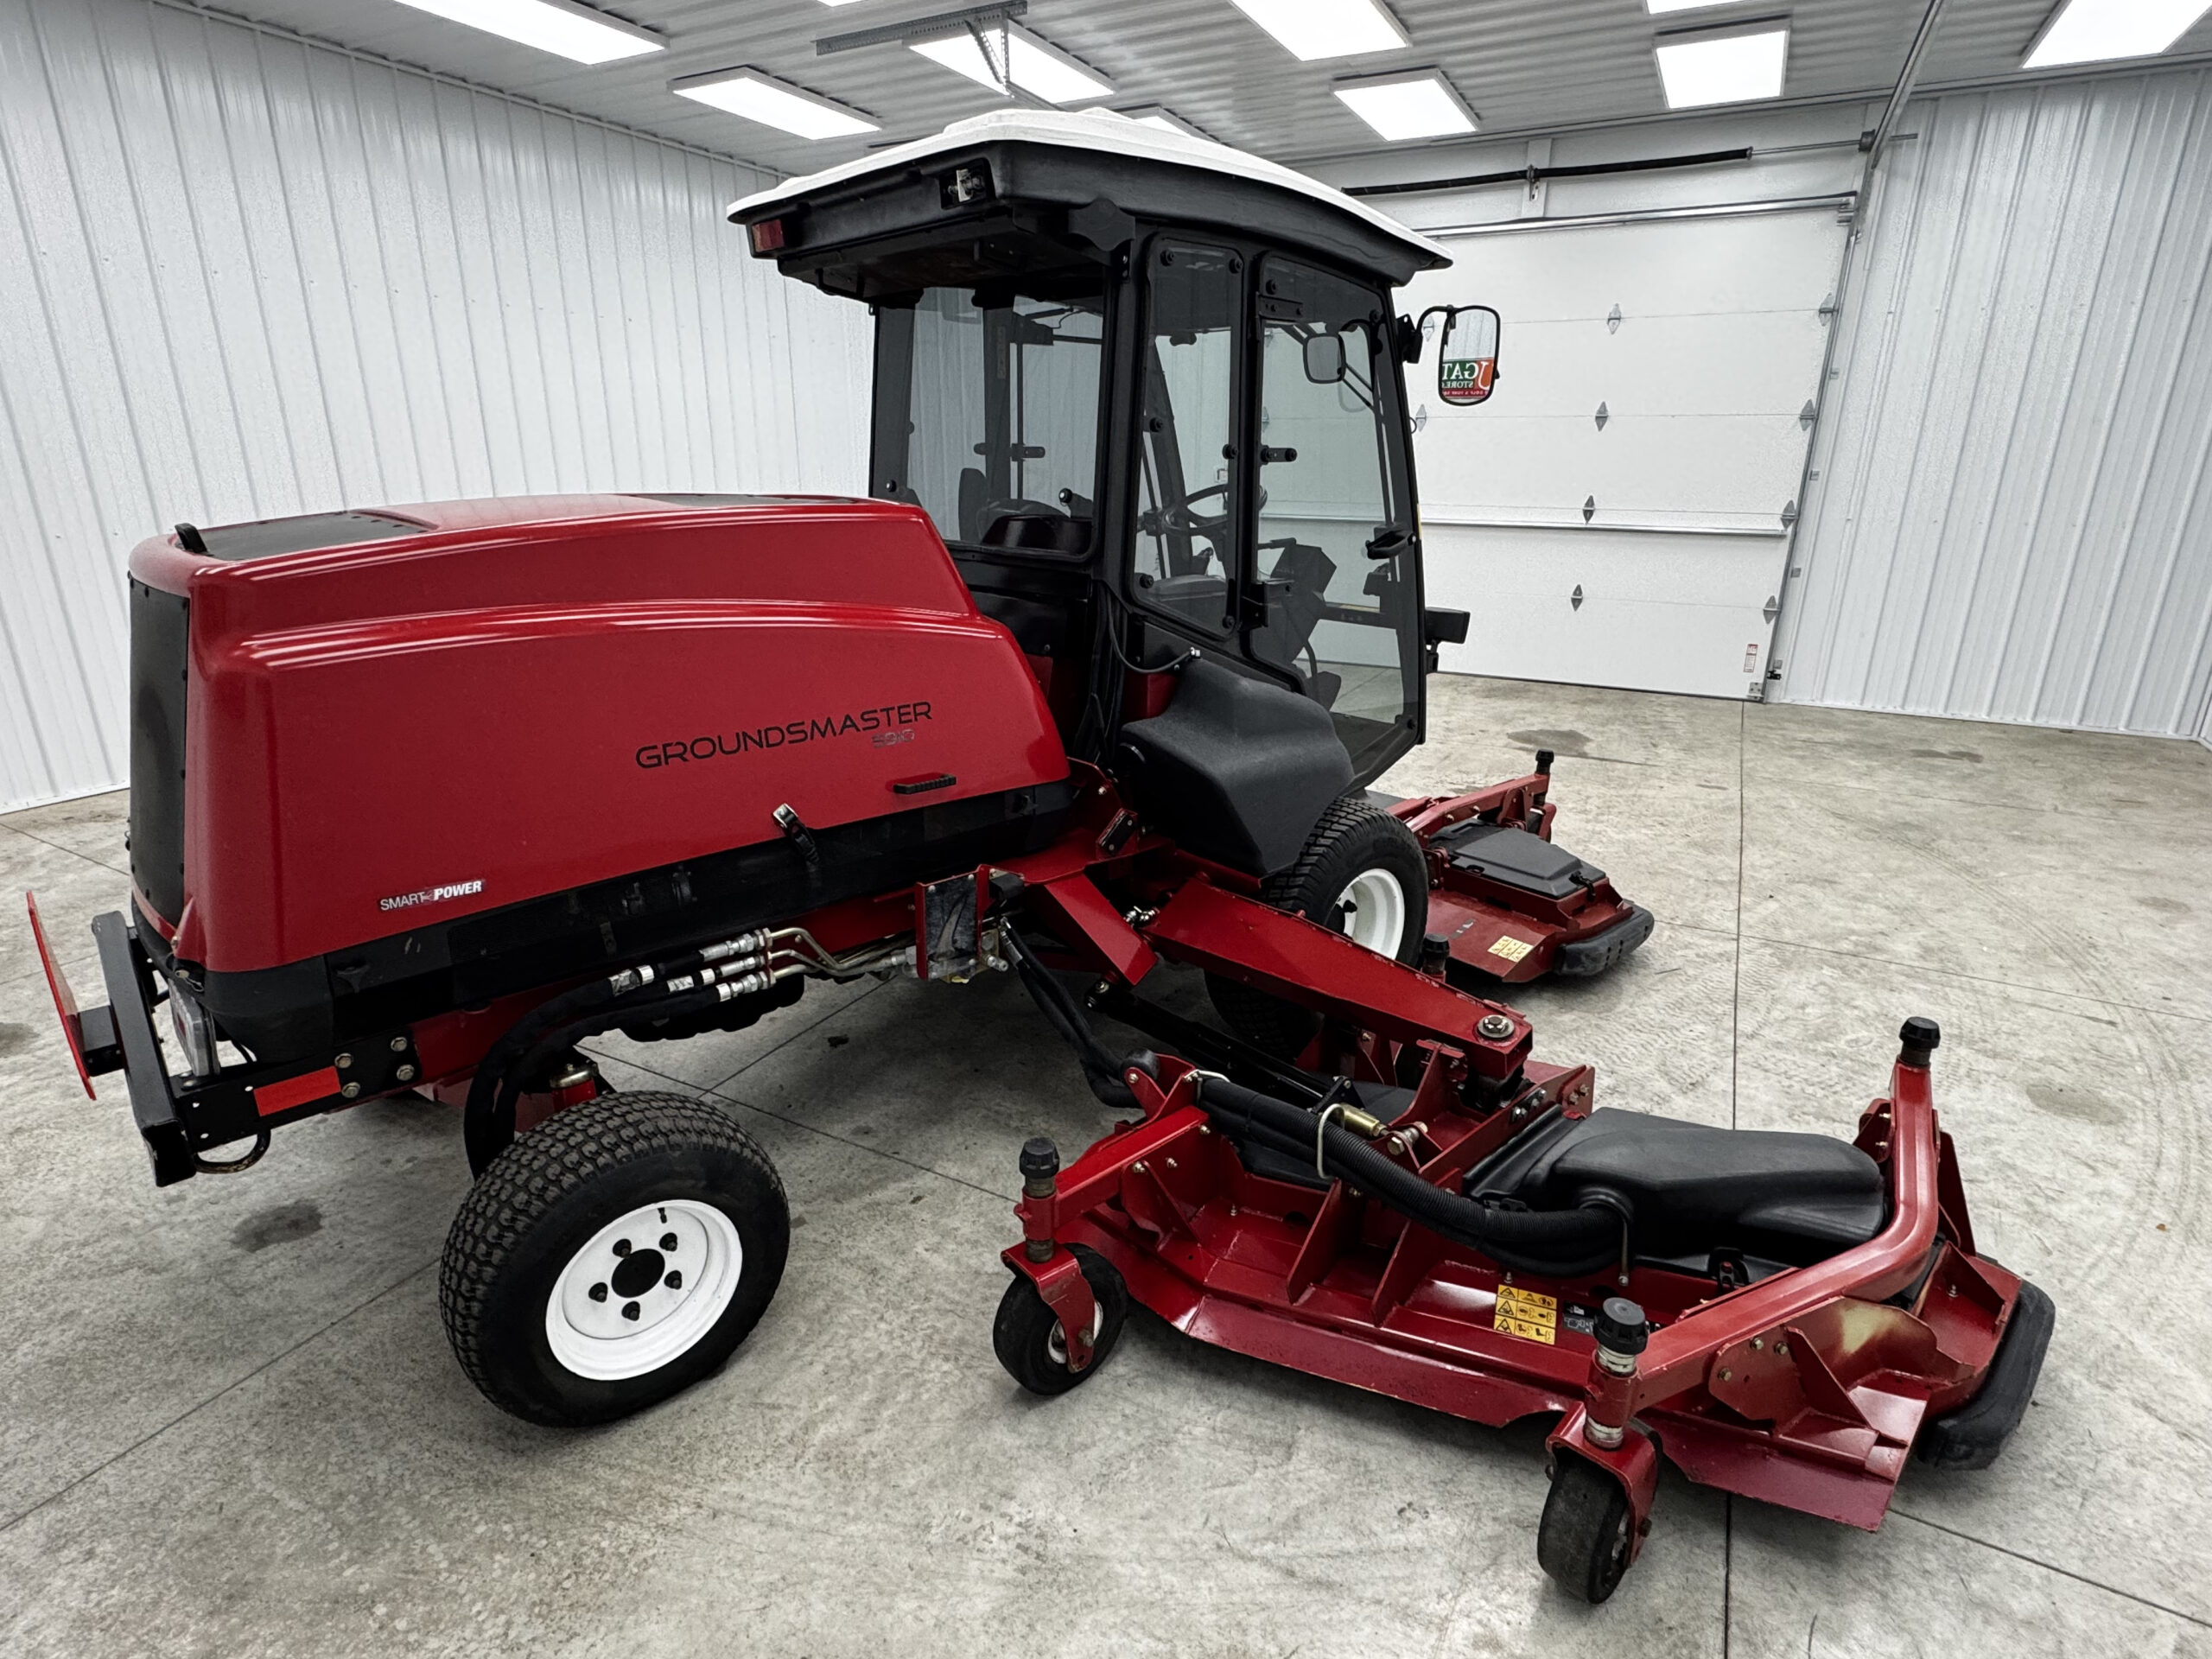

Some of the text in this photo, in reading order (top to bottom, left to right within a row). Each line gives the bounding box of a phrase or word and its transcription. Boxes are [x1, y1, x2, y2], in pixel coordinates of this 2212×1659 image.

[635, 701, 932, 769] GROUNDSMASTER
[380, 880, 482, 911] SMART POWER
